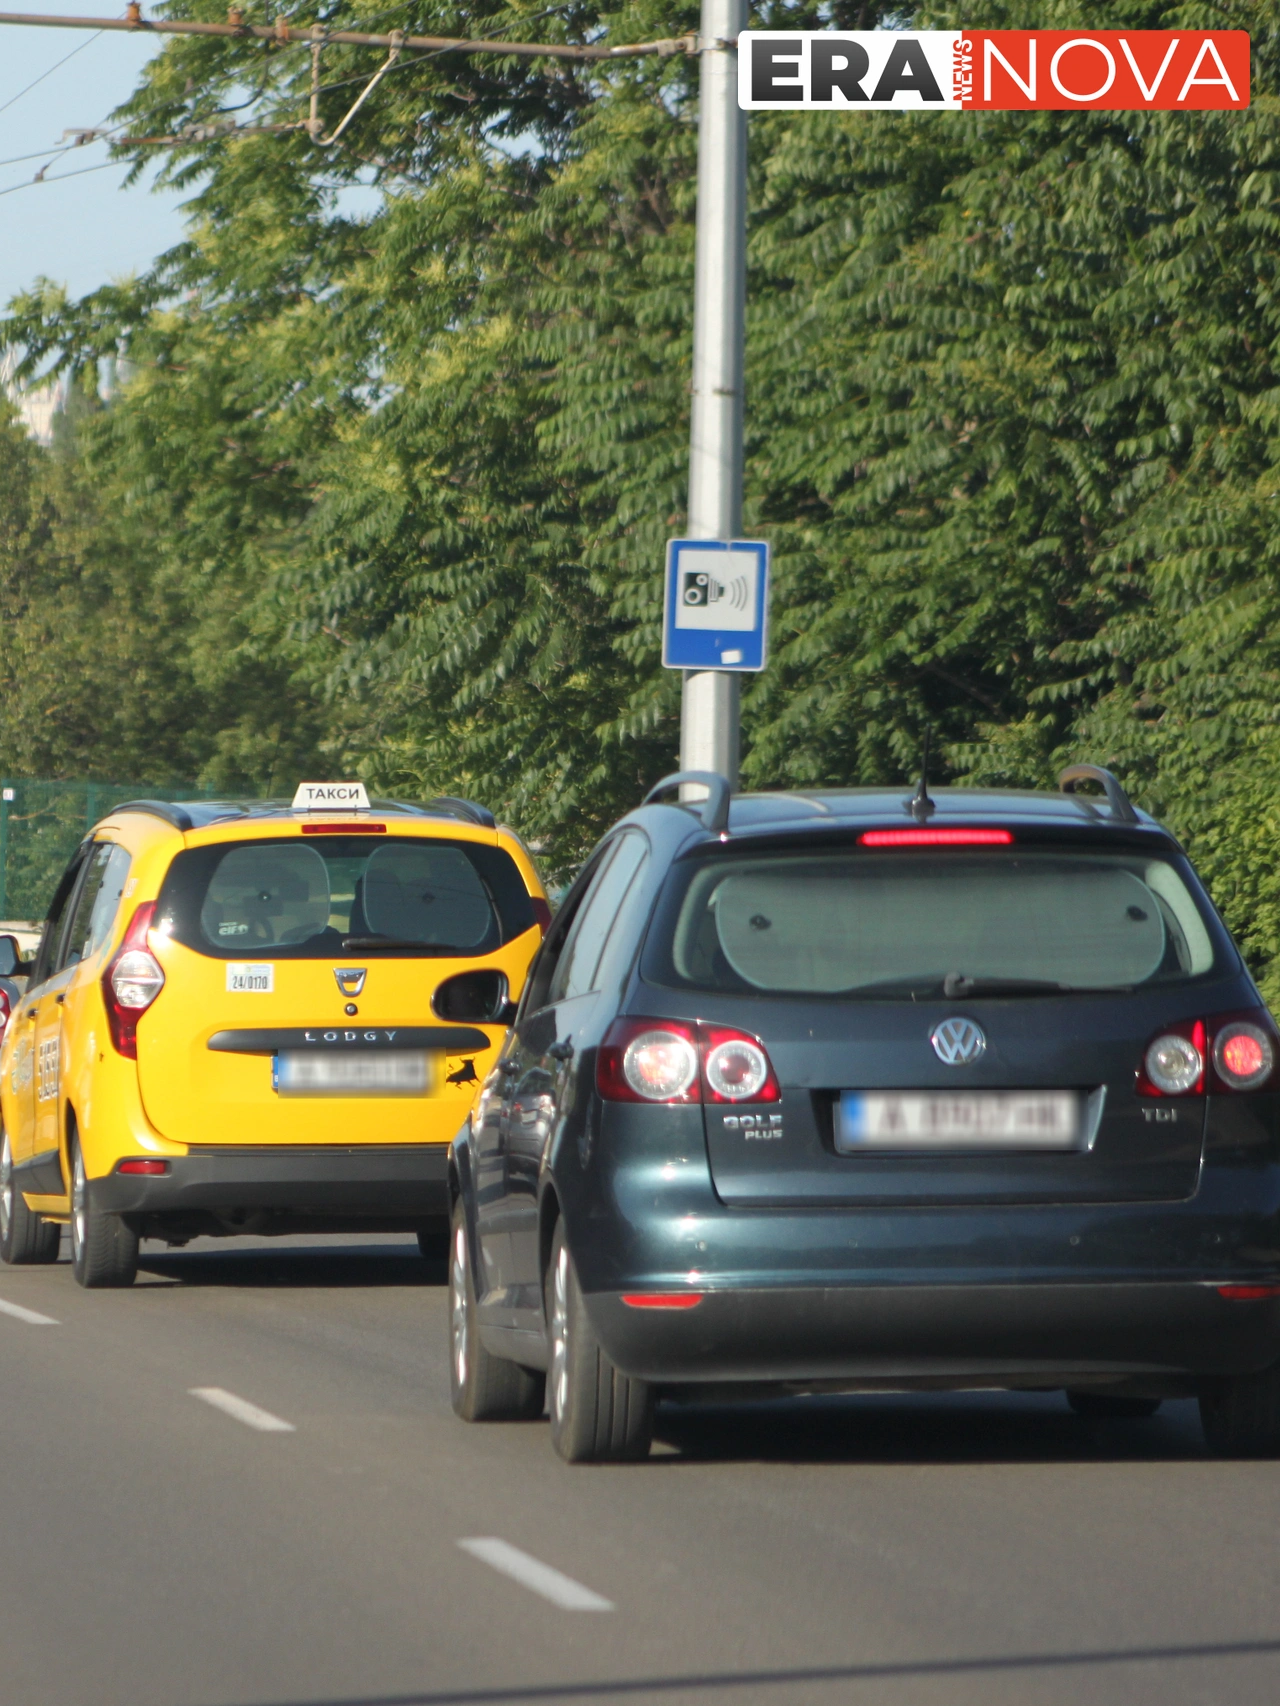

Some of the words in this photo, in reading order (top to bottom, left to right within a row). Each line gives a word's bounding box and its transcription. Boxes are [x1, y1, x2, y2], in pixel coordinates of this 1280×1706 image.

[306, 788, 359, 799] ТАКСИ
[304, 1031, 397, 1042] LODGY
[1141, 1107, 1177, 1122] TDI
[723, 1114, 782, 1129] GOLF
[744, 1129, 783, 1140] PLUS
